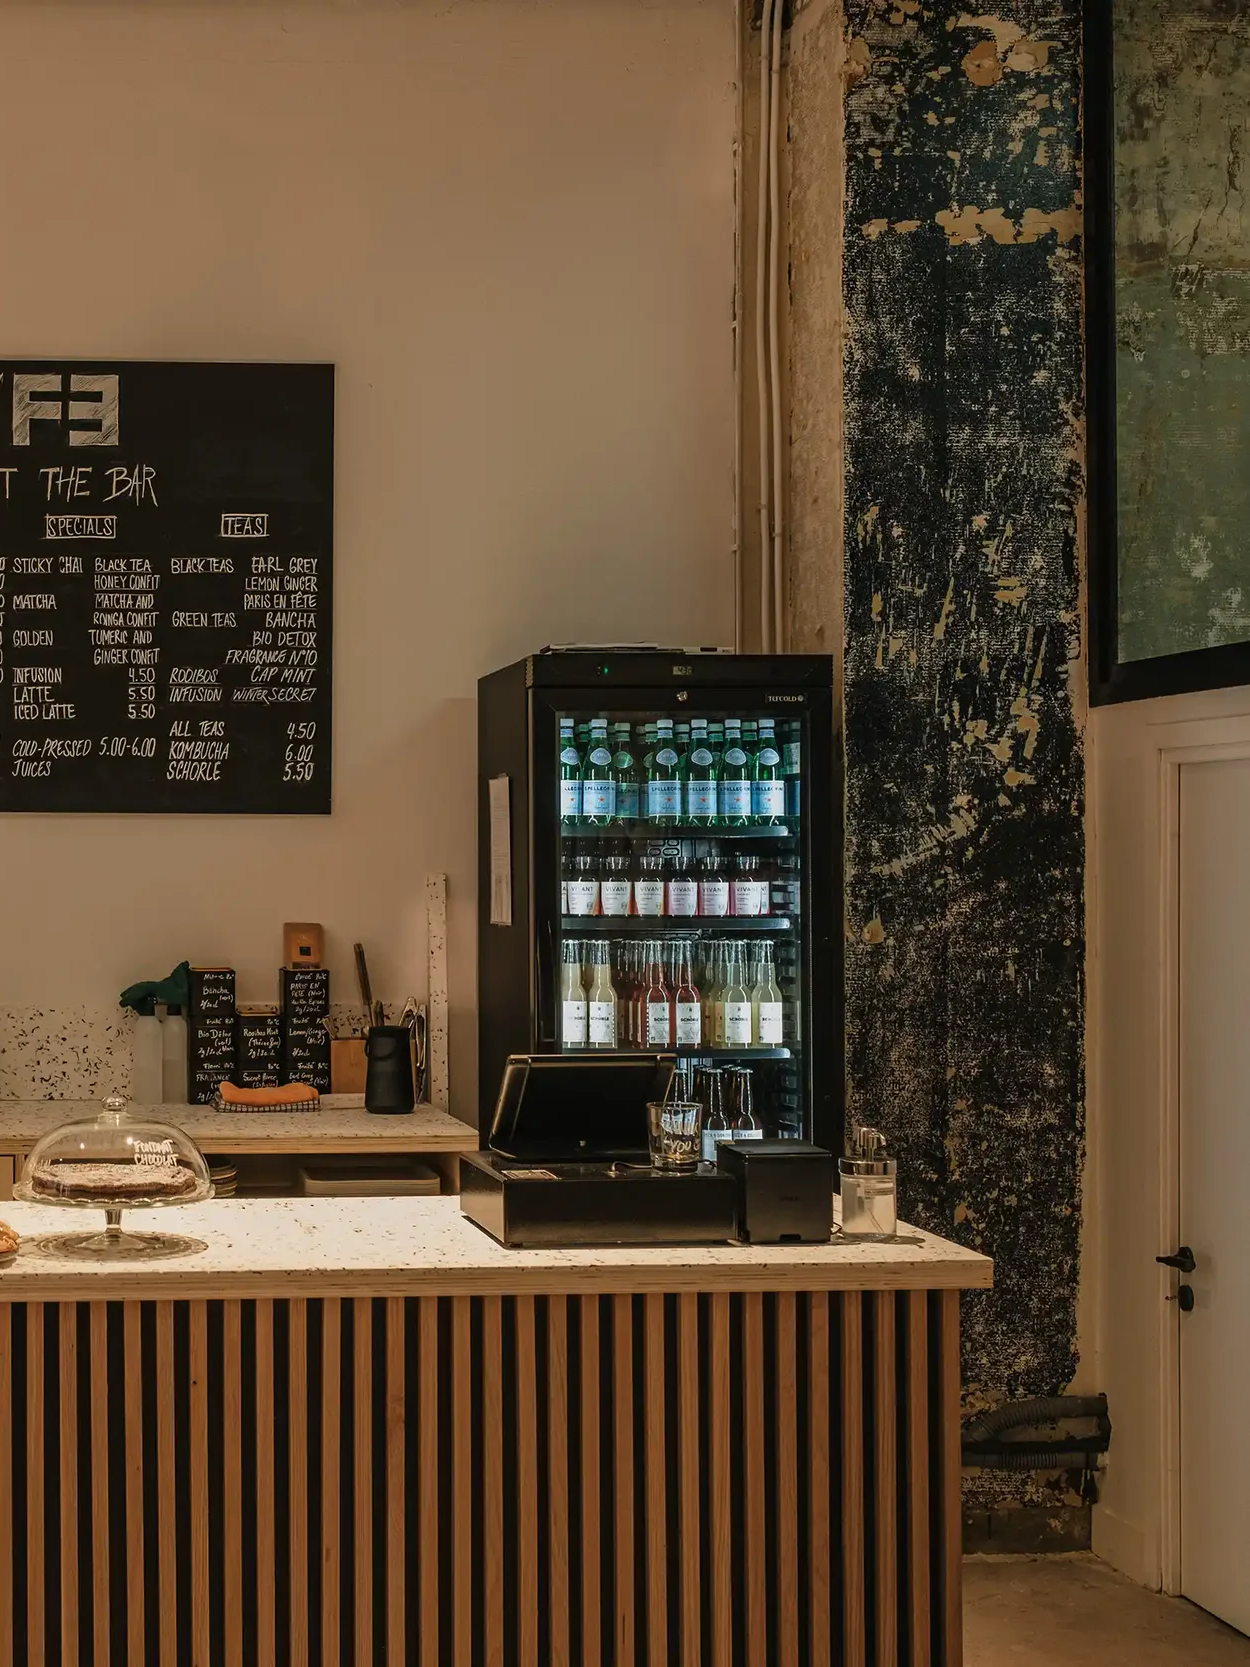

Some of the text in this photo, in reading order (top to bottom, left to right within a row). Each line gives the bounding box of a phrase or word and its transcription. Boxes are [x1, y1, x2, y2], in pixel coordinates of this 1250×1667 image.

[38, 466, 93, 501] THE
[103, 464, 158, 507] BAR
[48, 517, 113, 537] SPECIALS
[224, 516, 264, 535] TEAS
[12, 556, 83, 574] STICKY CHAI
[95, 557, 153, 573] BLACK TEA
[171, 557, 234, 574] BLACK TEAS
[251, 556, 318, 574] EARL GREY
[94, 574, 161, 590] HONEY CONFIT
[245, 574, 318, 592] LEMON GINGER
[12, 594, 57, 610] MATCHA
[95, 594, 154, 609] MATCHA AND
[243, 591, 317, 610] PARIS EN FÊTE
[126, 611, 159, 627] CONFIT
[172, 611, 237, 627] GREEN TEAS
[265, 611, 316, 628] BANCHA
[12, 630, 54, 646] GOLDEN
[88, 629, 153, 645] TUMERIC AND
[252, 631, 317, 648] BIO DETOX
[93, 648, 160, 665] GINGER CONFIT
[225, 649, 287, 665] FRAGRANCE
[12, 667, 156, 684] INFUSION 4.50
[169, 667, 219, 683] ROOIBOS
[251, 665, 317, 683] CAP MINT
[13, 686, 156, 703] LATTE 5.50
[169, 686, 223, 702] INFUSION
[232, 687, 317, 705] WINTER SECRET
[14, 703, 156, 720] ICED LATTE 5.50
[169, 720, 317, 740] ALL TEAS 4.50
[12, 736, 157, 759] COLD-PRESSED 5.00-6.00
[168, 740, 314, 762] KOMBUCHA 6.00
[11, 758, 52, 778] JUICES
[166, 761, 315, 782] SCHORLE 5.50
[133, 1139, 174, 1154] FONDANT
